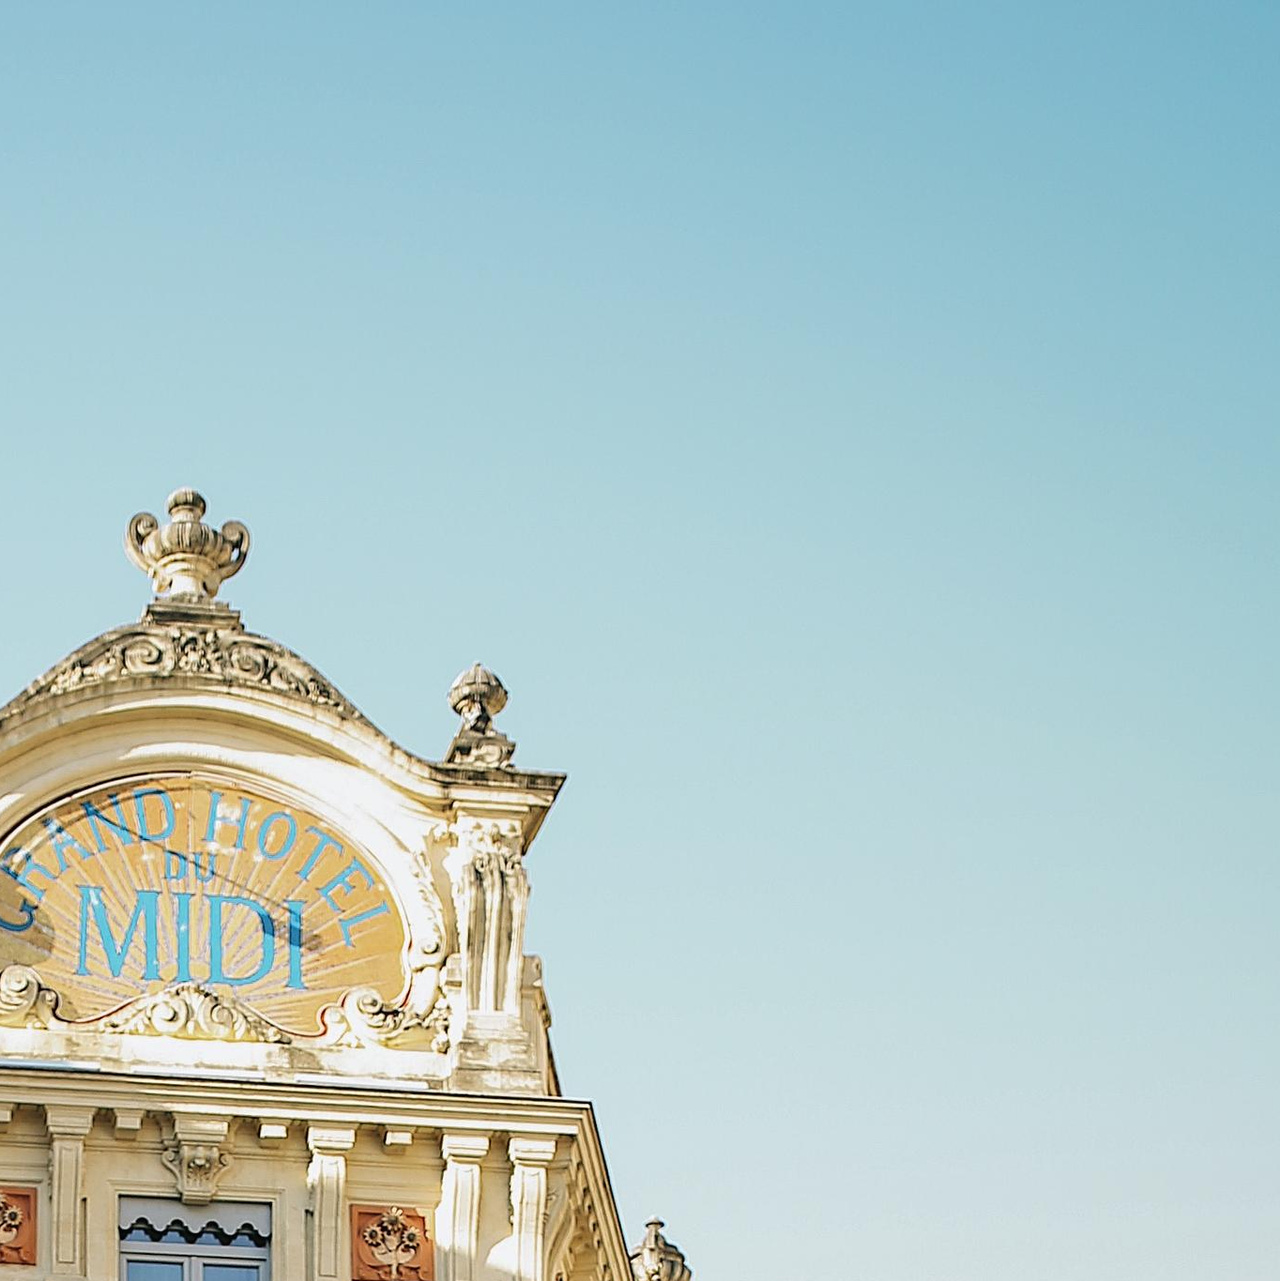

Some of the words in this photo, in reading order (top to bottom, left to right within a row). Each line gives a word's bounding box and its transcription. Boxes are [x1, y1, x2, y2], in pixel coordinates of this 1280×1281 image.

[163, 849, 218, 883] DU
[202, 790, 392, 948] HOTEL
[76, 884, 309, 990] MIDI
